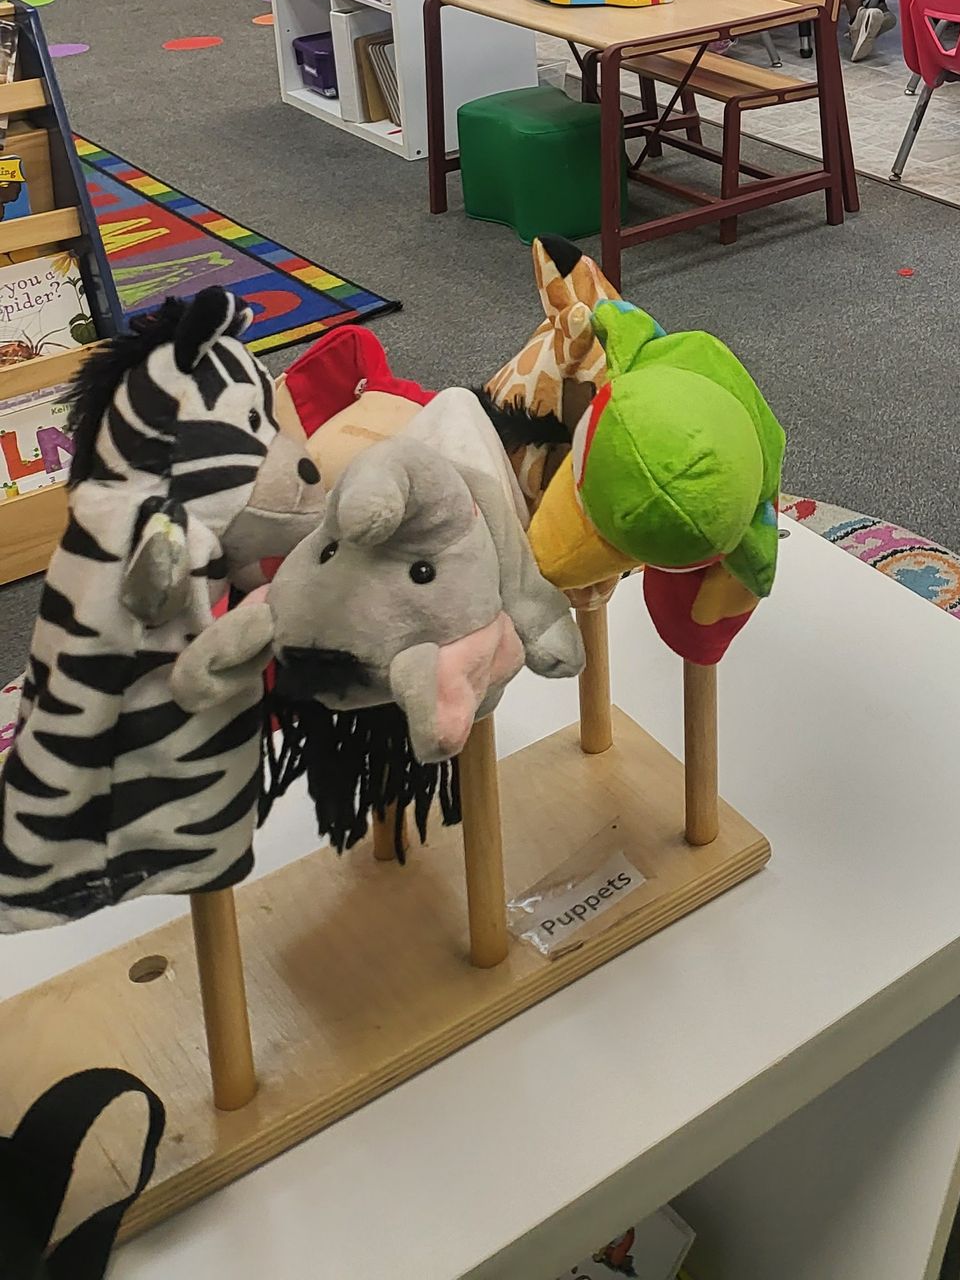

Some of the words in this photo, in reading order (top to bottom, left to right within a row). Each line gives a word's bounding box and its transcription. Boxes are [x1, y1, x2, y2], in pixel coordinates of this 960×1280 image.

[4, 274, 42, 299] you
[45, 271, 56, 281] a
[540, 872, 632, 935] Puppets
